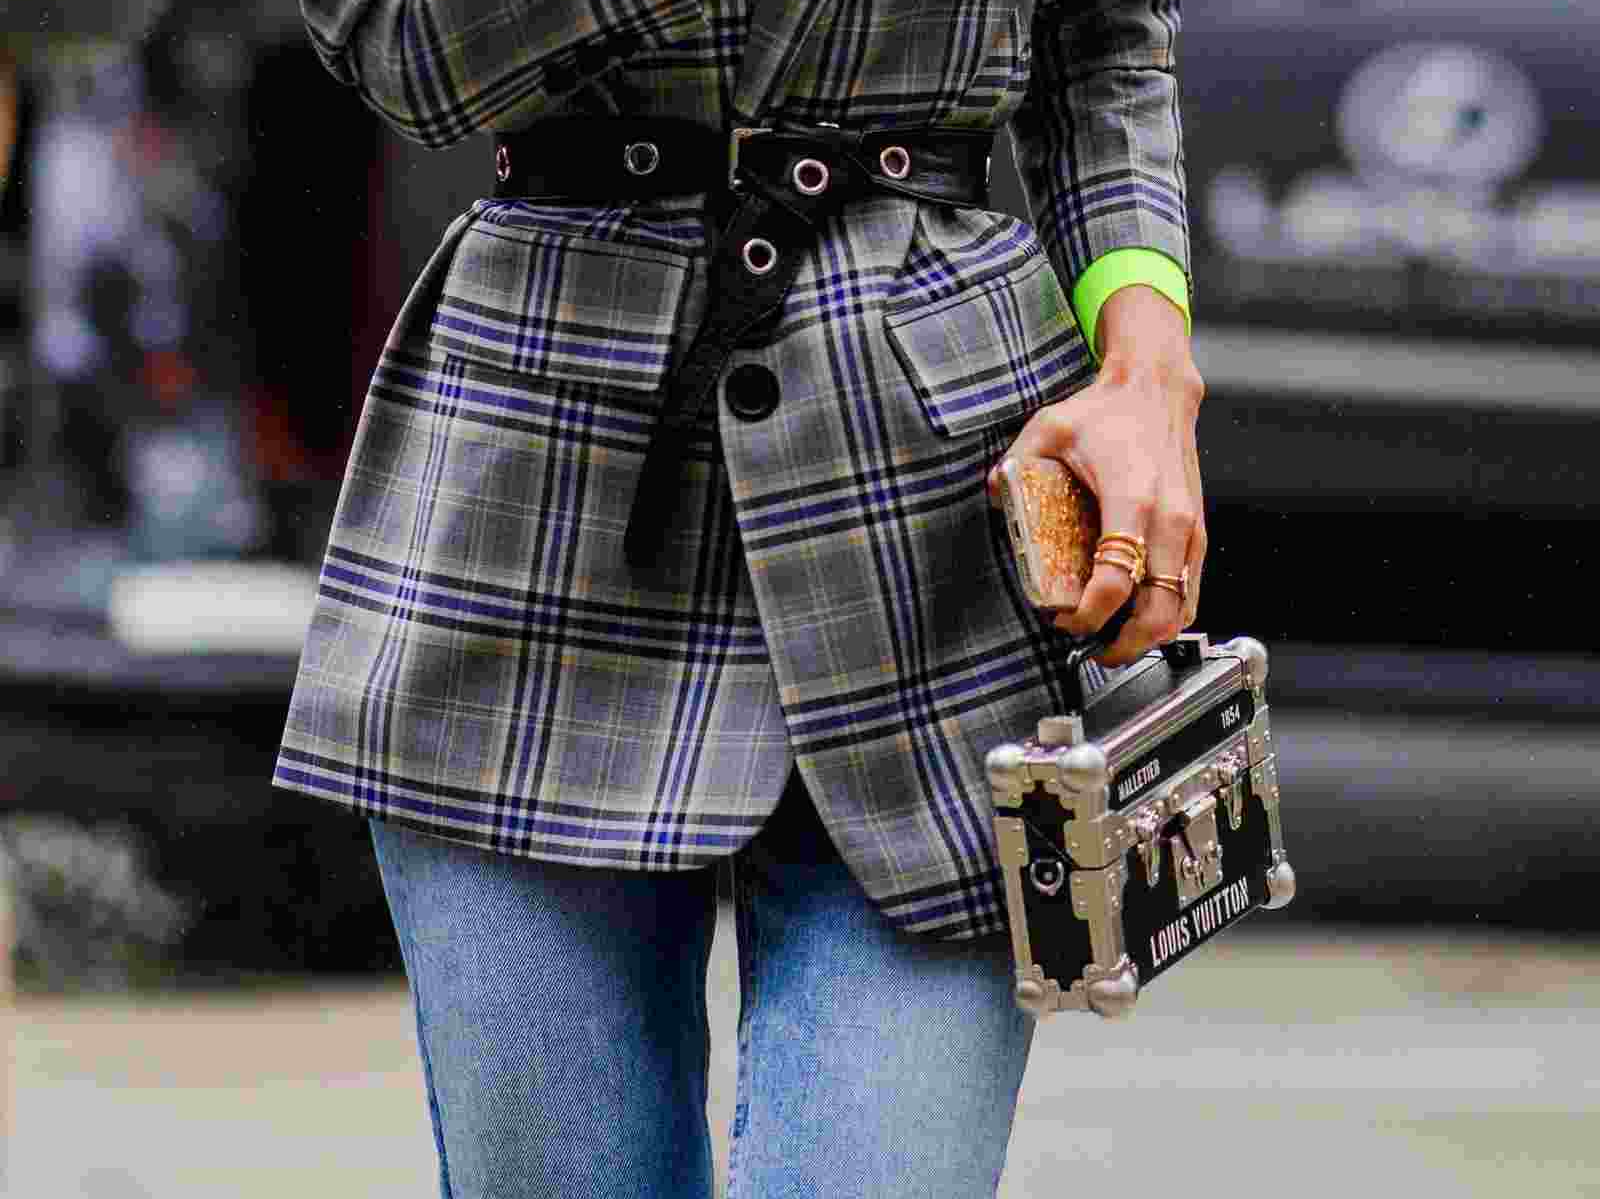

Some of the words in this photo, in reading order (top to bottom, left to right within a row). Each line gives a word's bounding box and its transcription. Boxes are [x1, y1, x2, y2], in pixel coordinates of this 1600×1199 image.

[1118, 759, 1160, 802] MALLETIER
[1220, 704, 1240, 728] 1854
[1150, 916, 1190, 967] LOUIS
[1192, 876, 1249, 938] VUITTON
